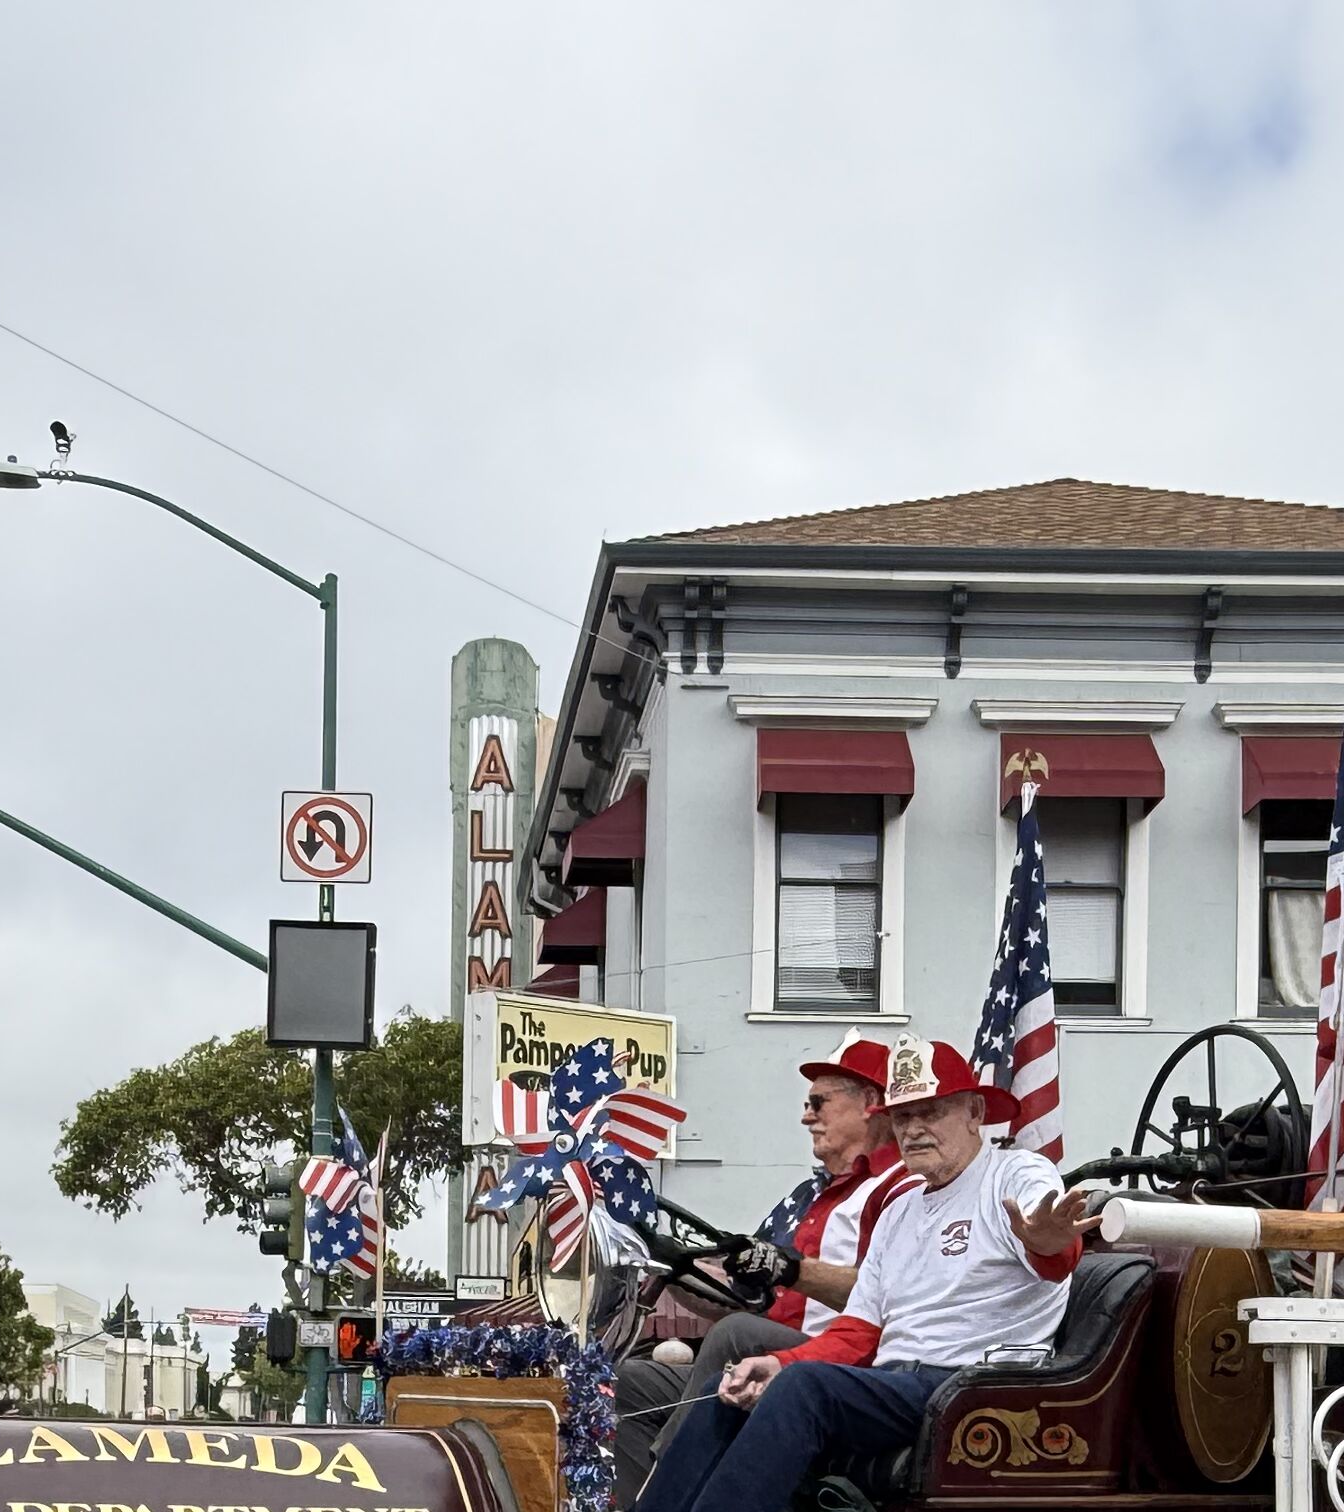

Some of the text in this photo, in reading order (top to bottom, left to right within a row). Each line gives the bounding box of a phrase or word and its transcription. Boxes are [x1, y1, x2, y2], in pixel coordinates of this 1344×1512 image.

[519, 1011, 546, 1038] The
[500, 1022, 667, 1084] Pampe Pup
[1208, 1328, 1244, 1377] 2
